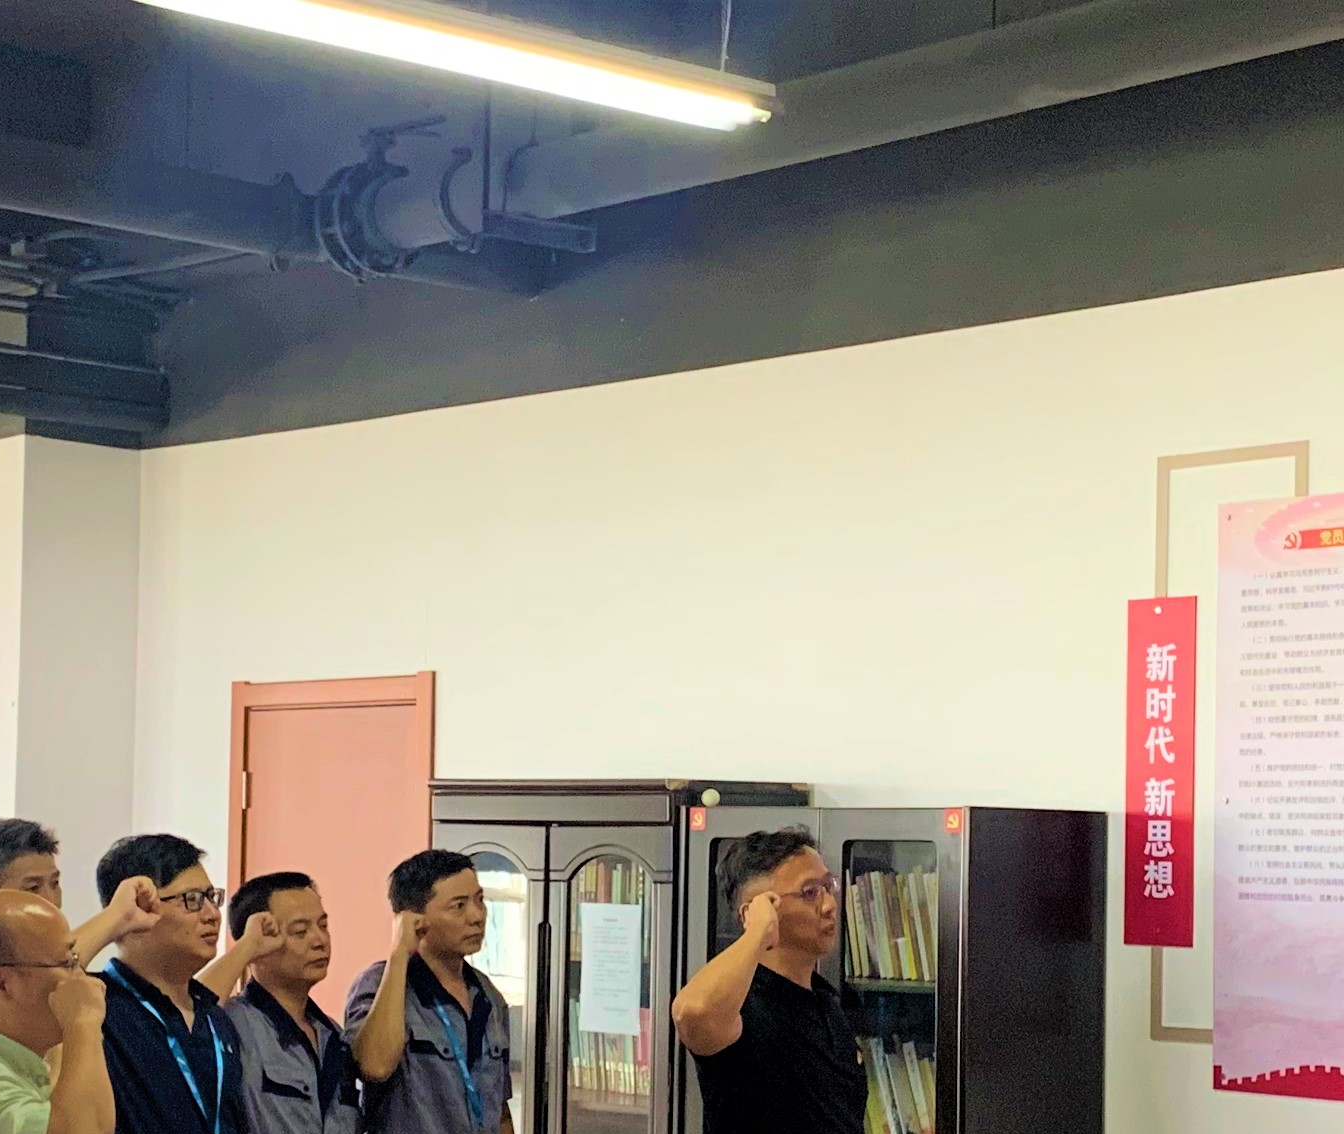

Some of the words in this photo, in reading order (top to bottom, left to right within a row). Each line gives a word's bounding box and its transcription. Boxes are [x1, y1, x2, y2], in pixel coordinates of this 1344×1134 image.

[1144, 643, 1178, 764] 新时代
[1143, 777, 1176, 899] 新思想
